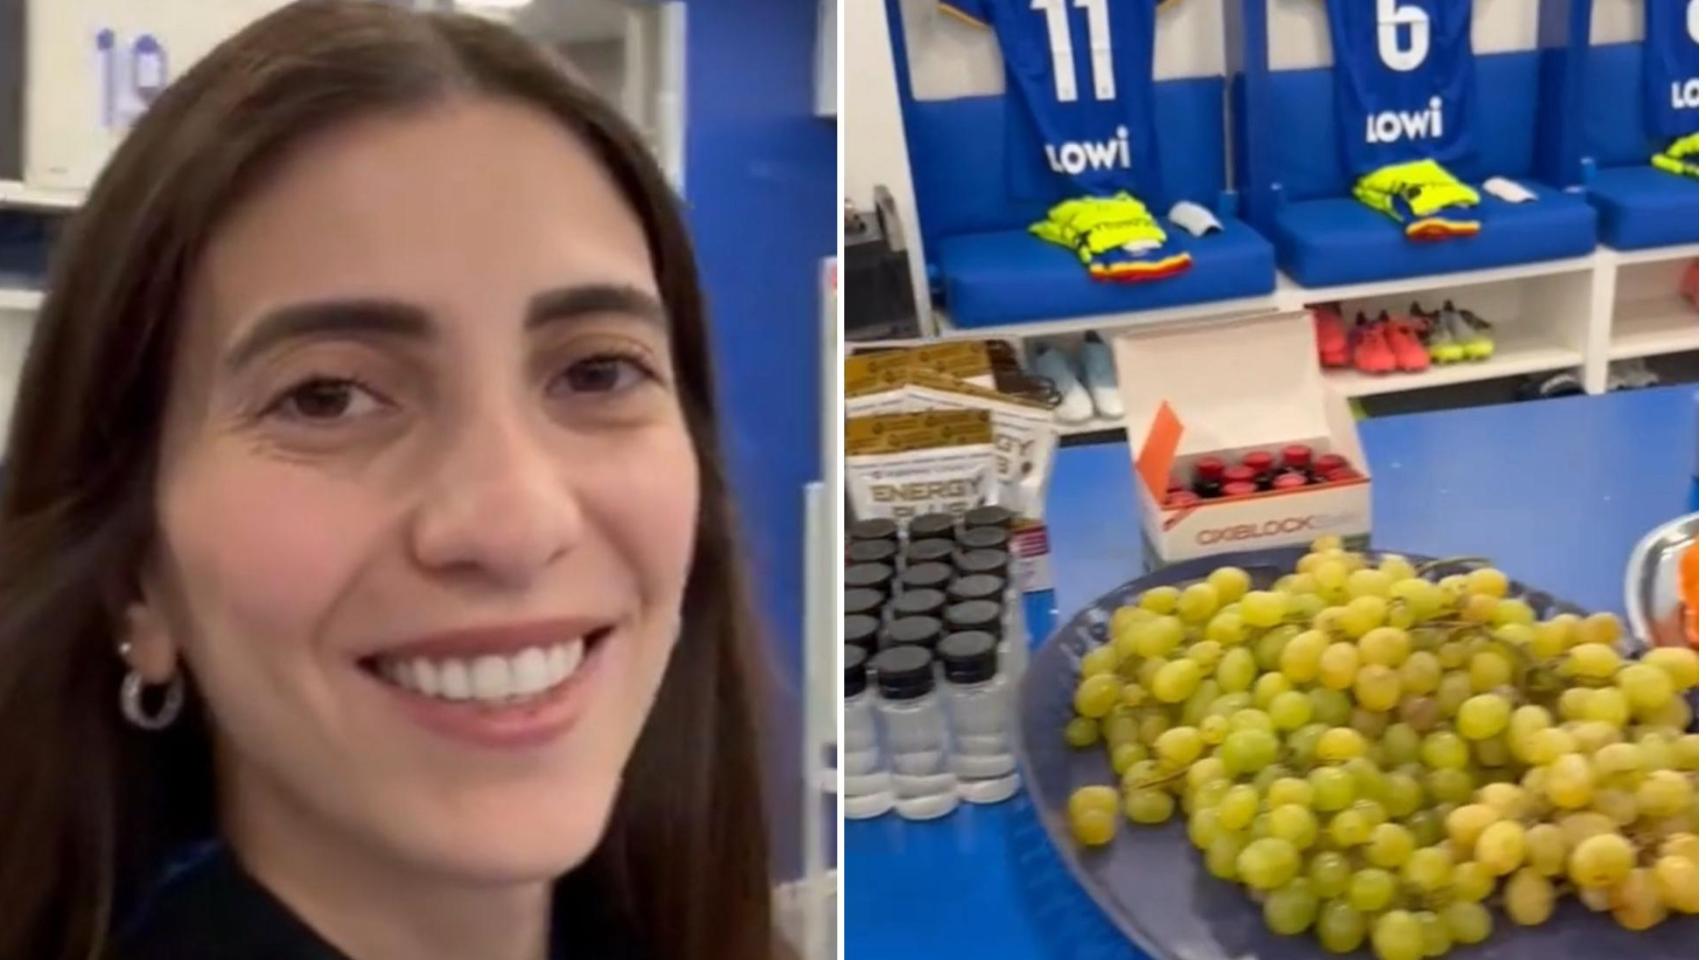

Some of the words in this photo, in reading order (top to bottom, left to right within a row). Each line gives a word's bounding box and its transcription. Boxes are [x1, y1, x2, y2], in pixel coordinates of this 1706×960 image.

[1031, 0, 1116, 101] 11
[1377, 0, 1430, 72] 6
[869, 474, 985, 502] ENERGY
